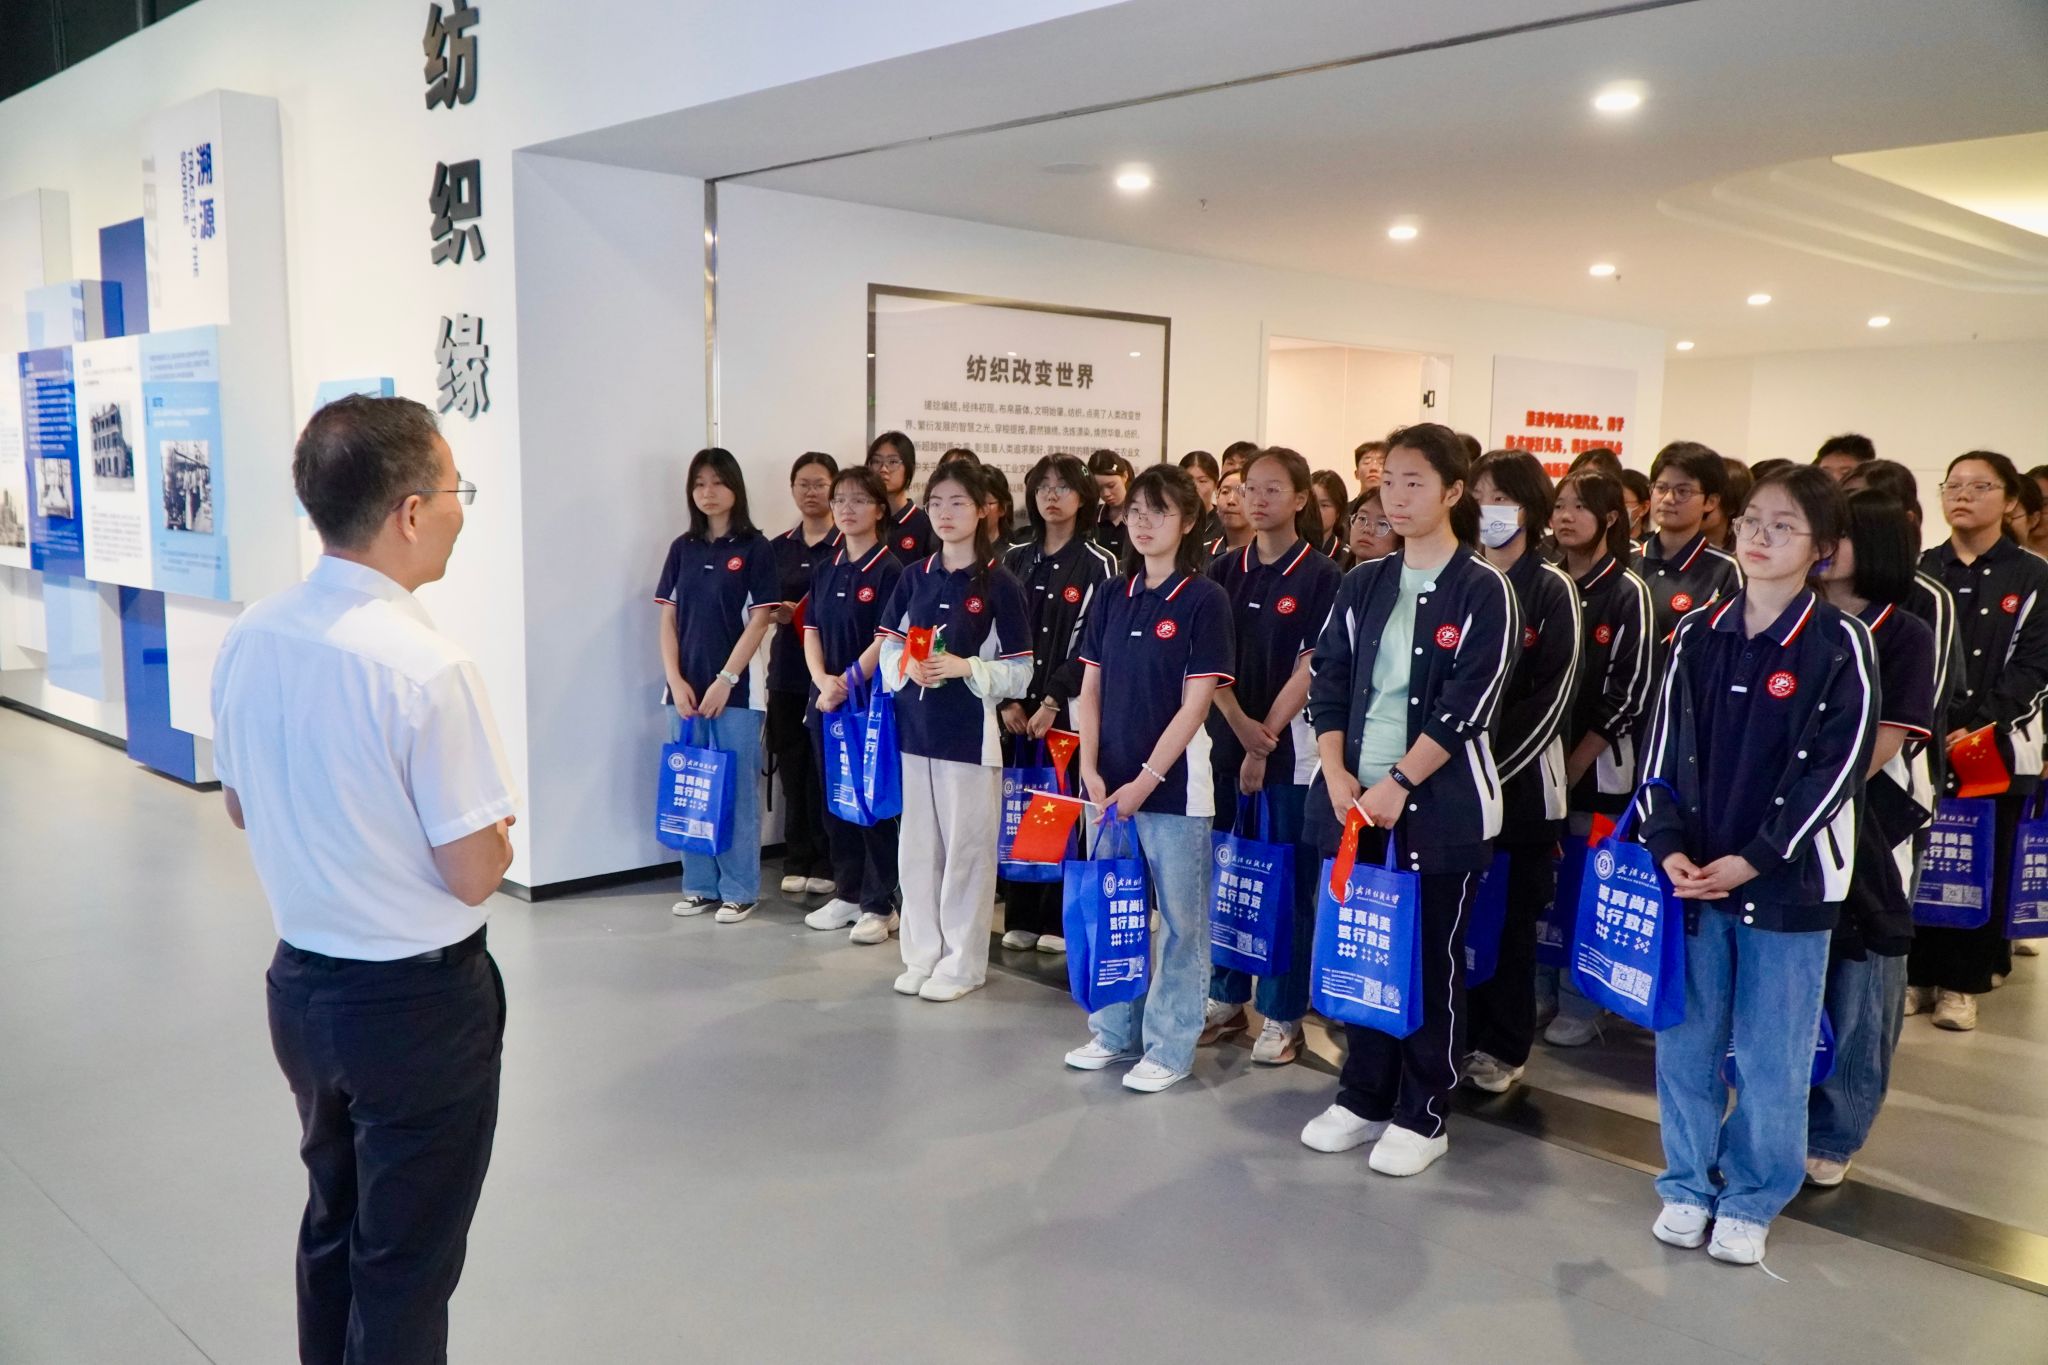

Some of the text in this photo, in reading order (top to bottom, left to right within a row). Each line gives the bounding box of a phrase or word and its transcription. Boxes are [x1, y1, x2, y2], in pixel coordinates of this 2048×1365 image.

[179, 151, 189, 225] SOURCE
[187, 148, 196, 208] TRACE
[196, 142, 216, 239] 溯源
[422, 0, 490, 420] 纺织缘
[190, 217, 198, 239] TO
[966, 354, 1095, 390] 纺织改变世界
